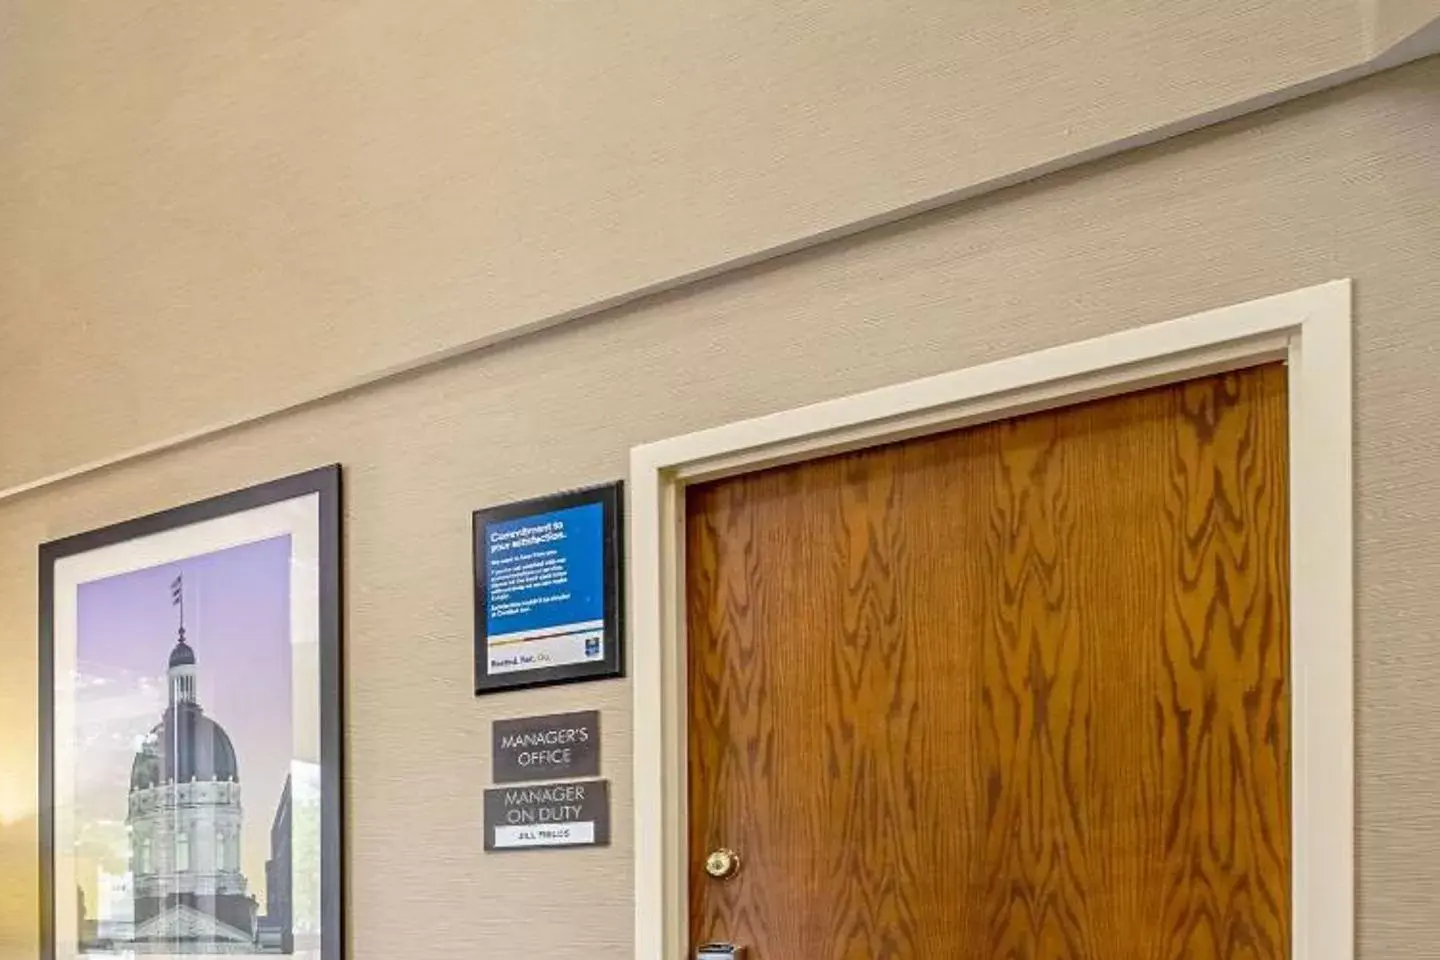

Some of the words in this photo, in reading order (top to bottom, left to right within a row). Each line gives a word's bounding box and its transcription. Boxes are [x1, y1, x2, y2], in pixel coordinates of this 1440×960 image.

[500, 727, 589, 749] MANAGER'S
[517, 748, 572, 767] OFFICE
[503, 785, 586, 807] MANAGER
[506, 806, 536, 825] ON
[538, 804, 583, 822] DUTY
